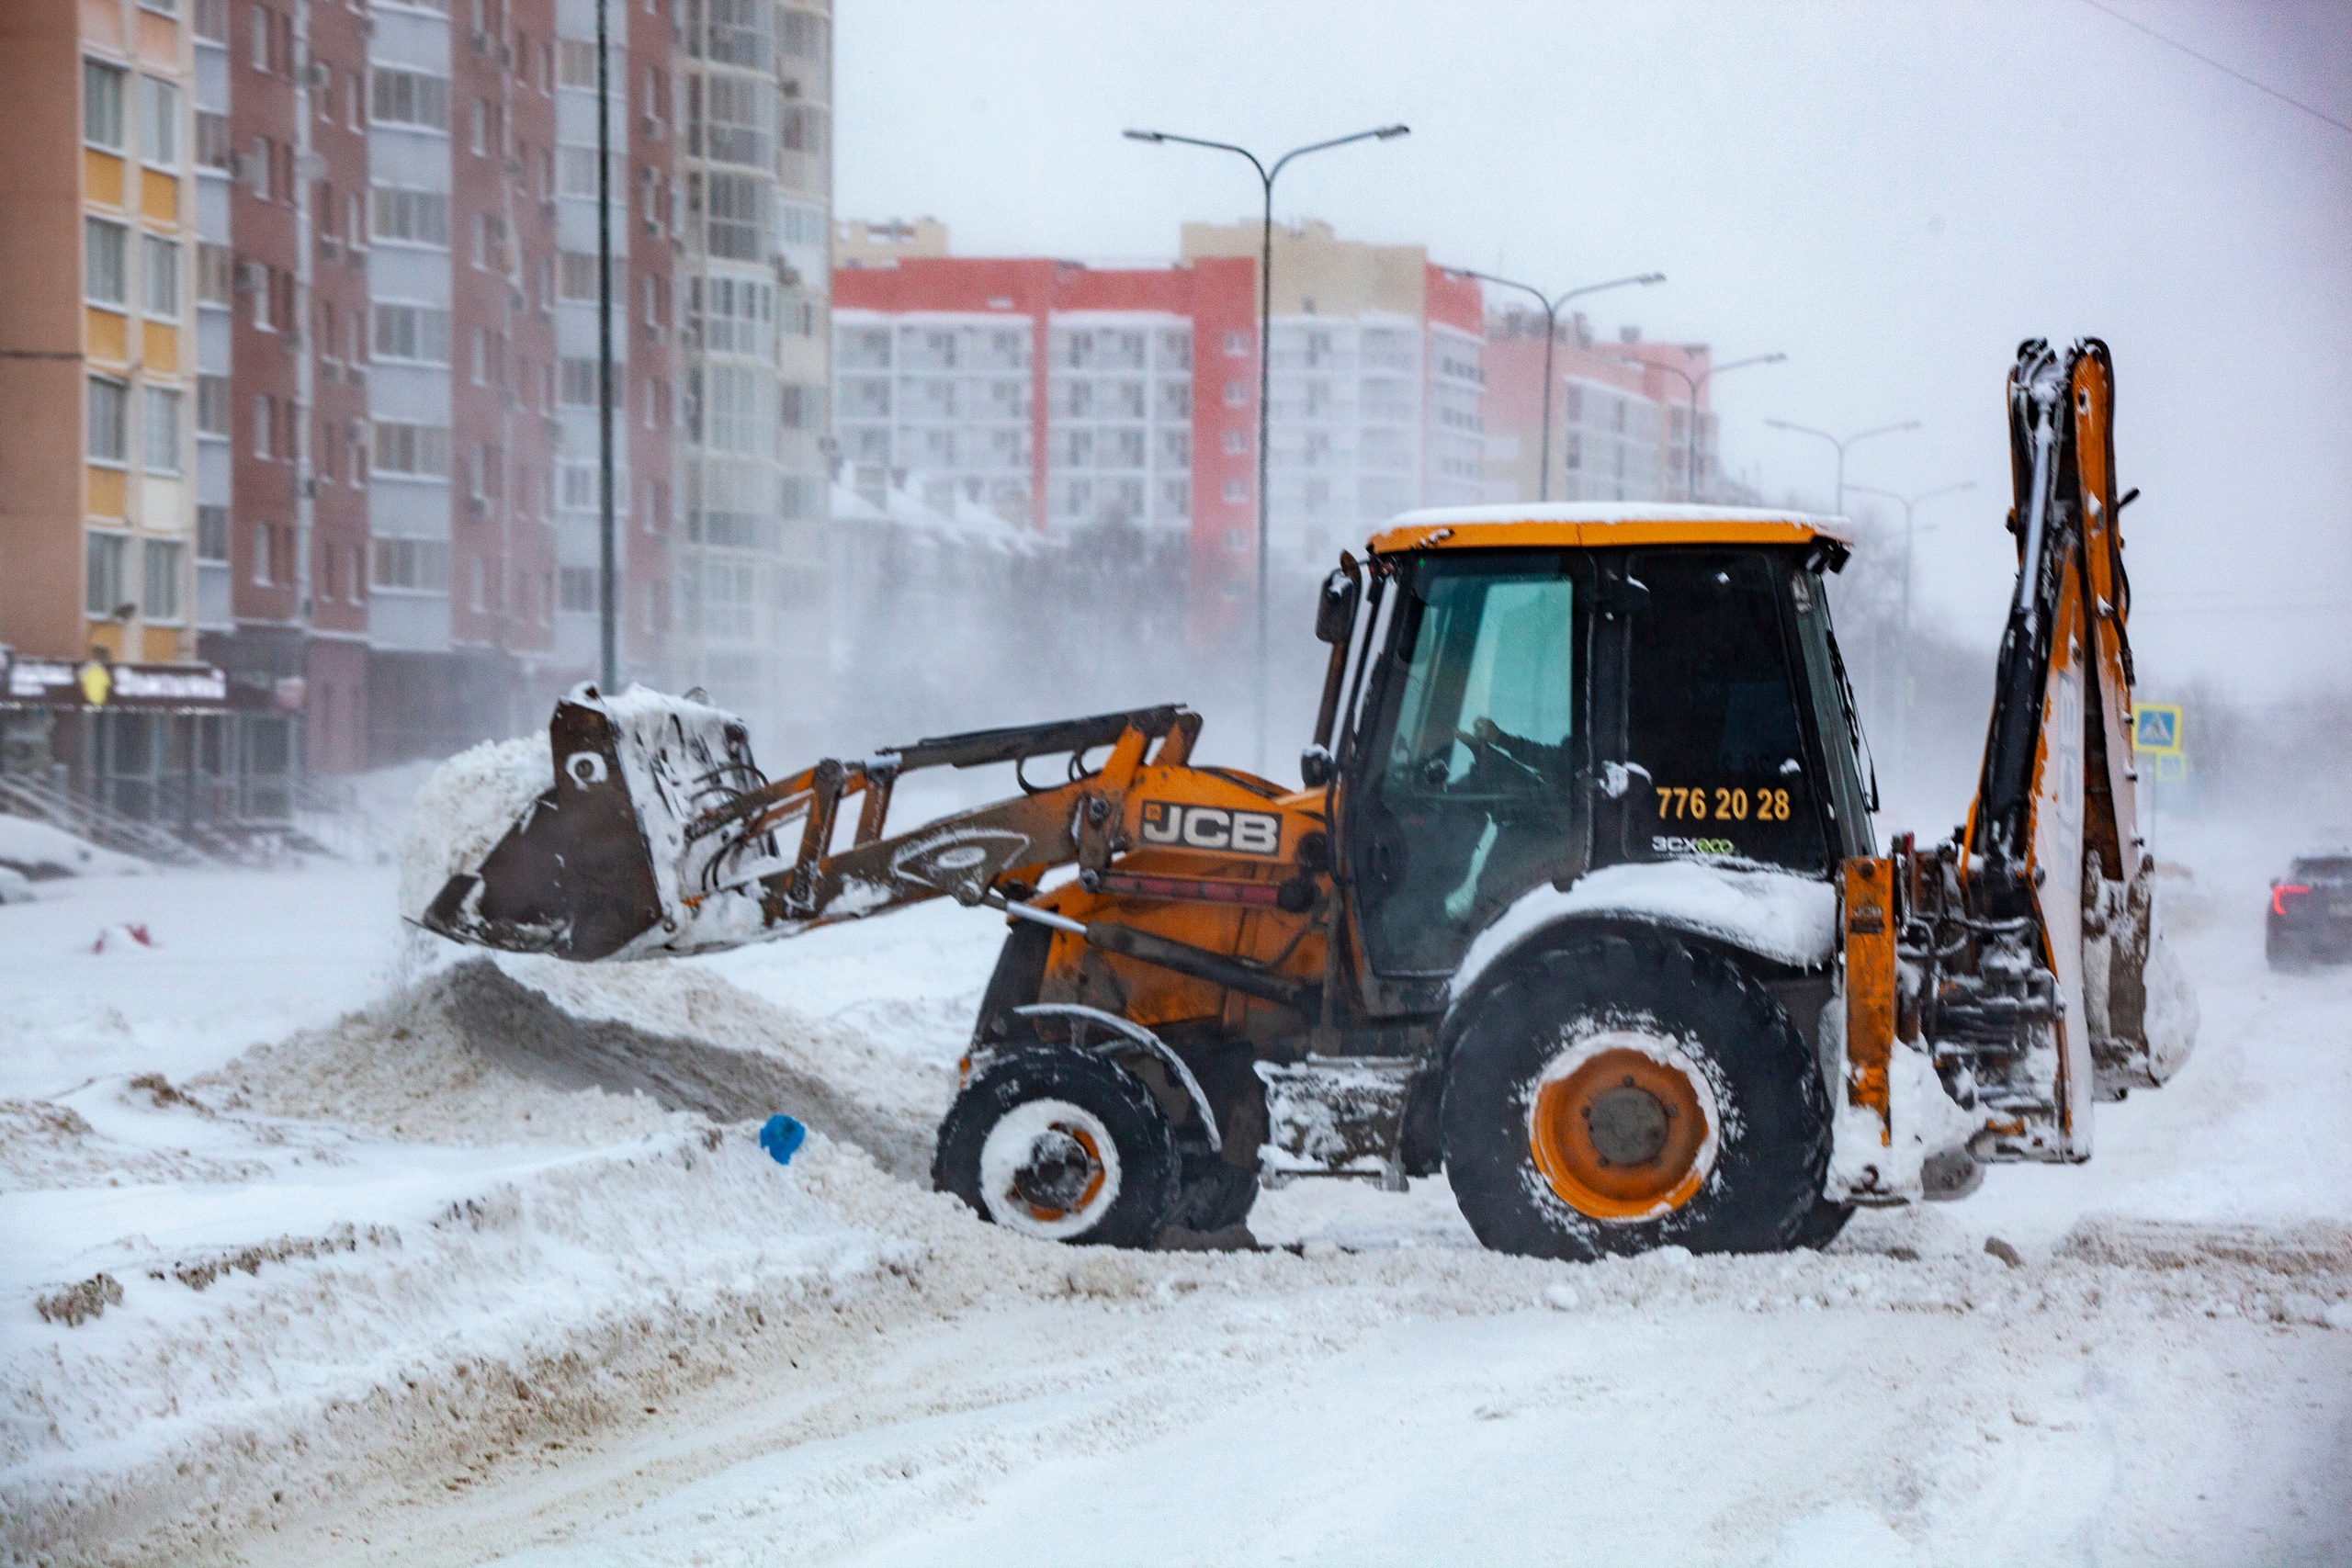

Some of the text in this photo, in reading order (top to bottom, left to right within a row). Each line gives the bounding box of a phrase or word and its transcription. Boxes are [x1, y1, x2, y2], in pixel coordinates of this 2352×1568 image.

[1656, 786, 1791, 820] 776 20 28
[1143, 805, 1278, 853] JCB
